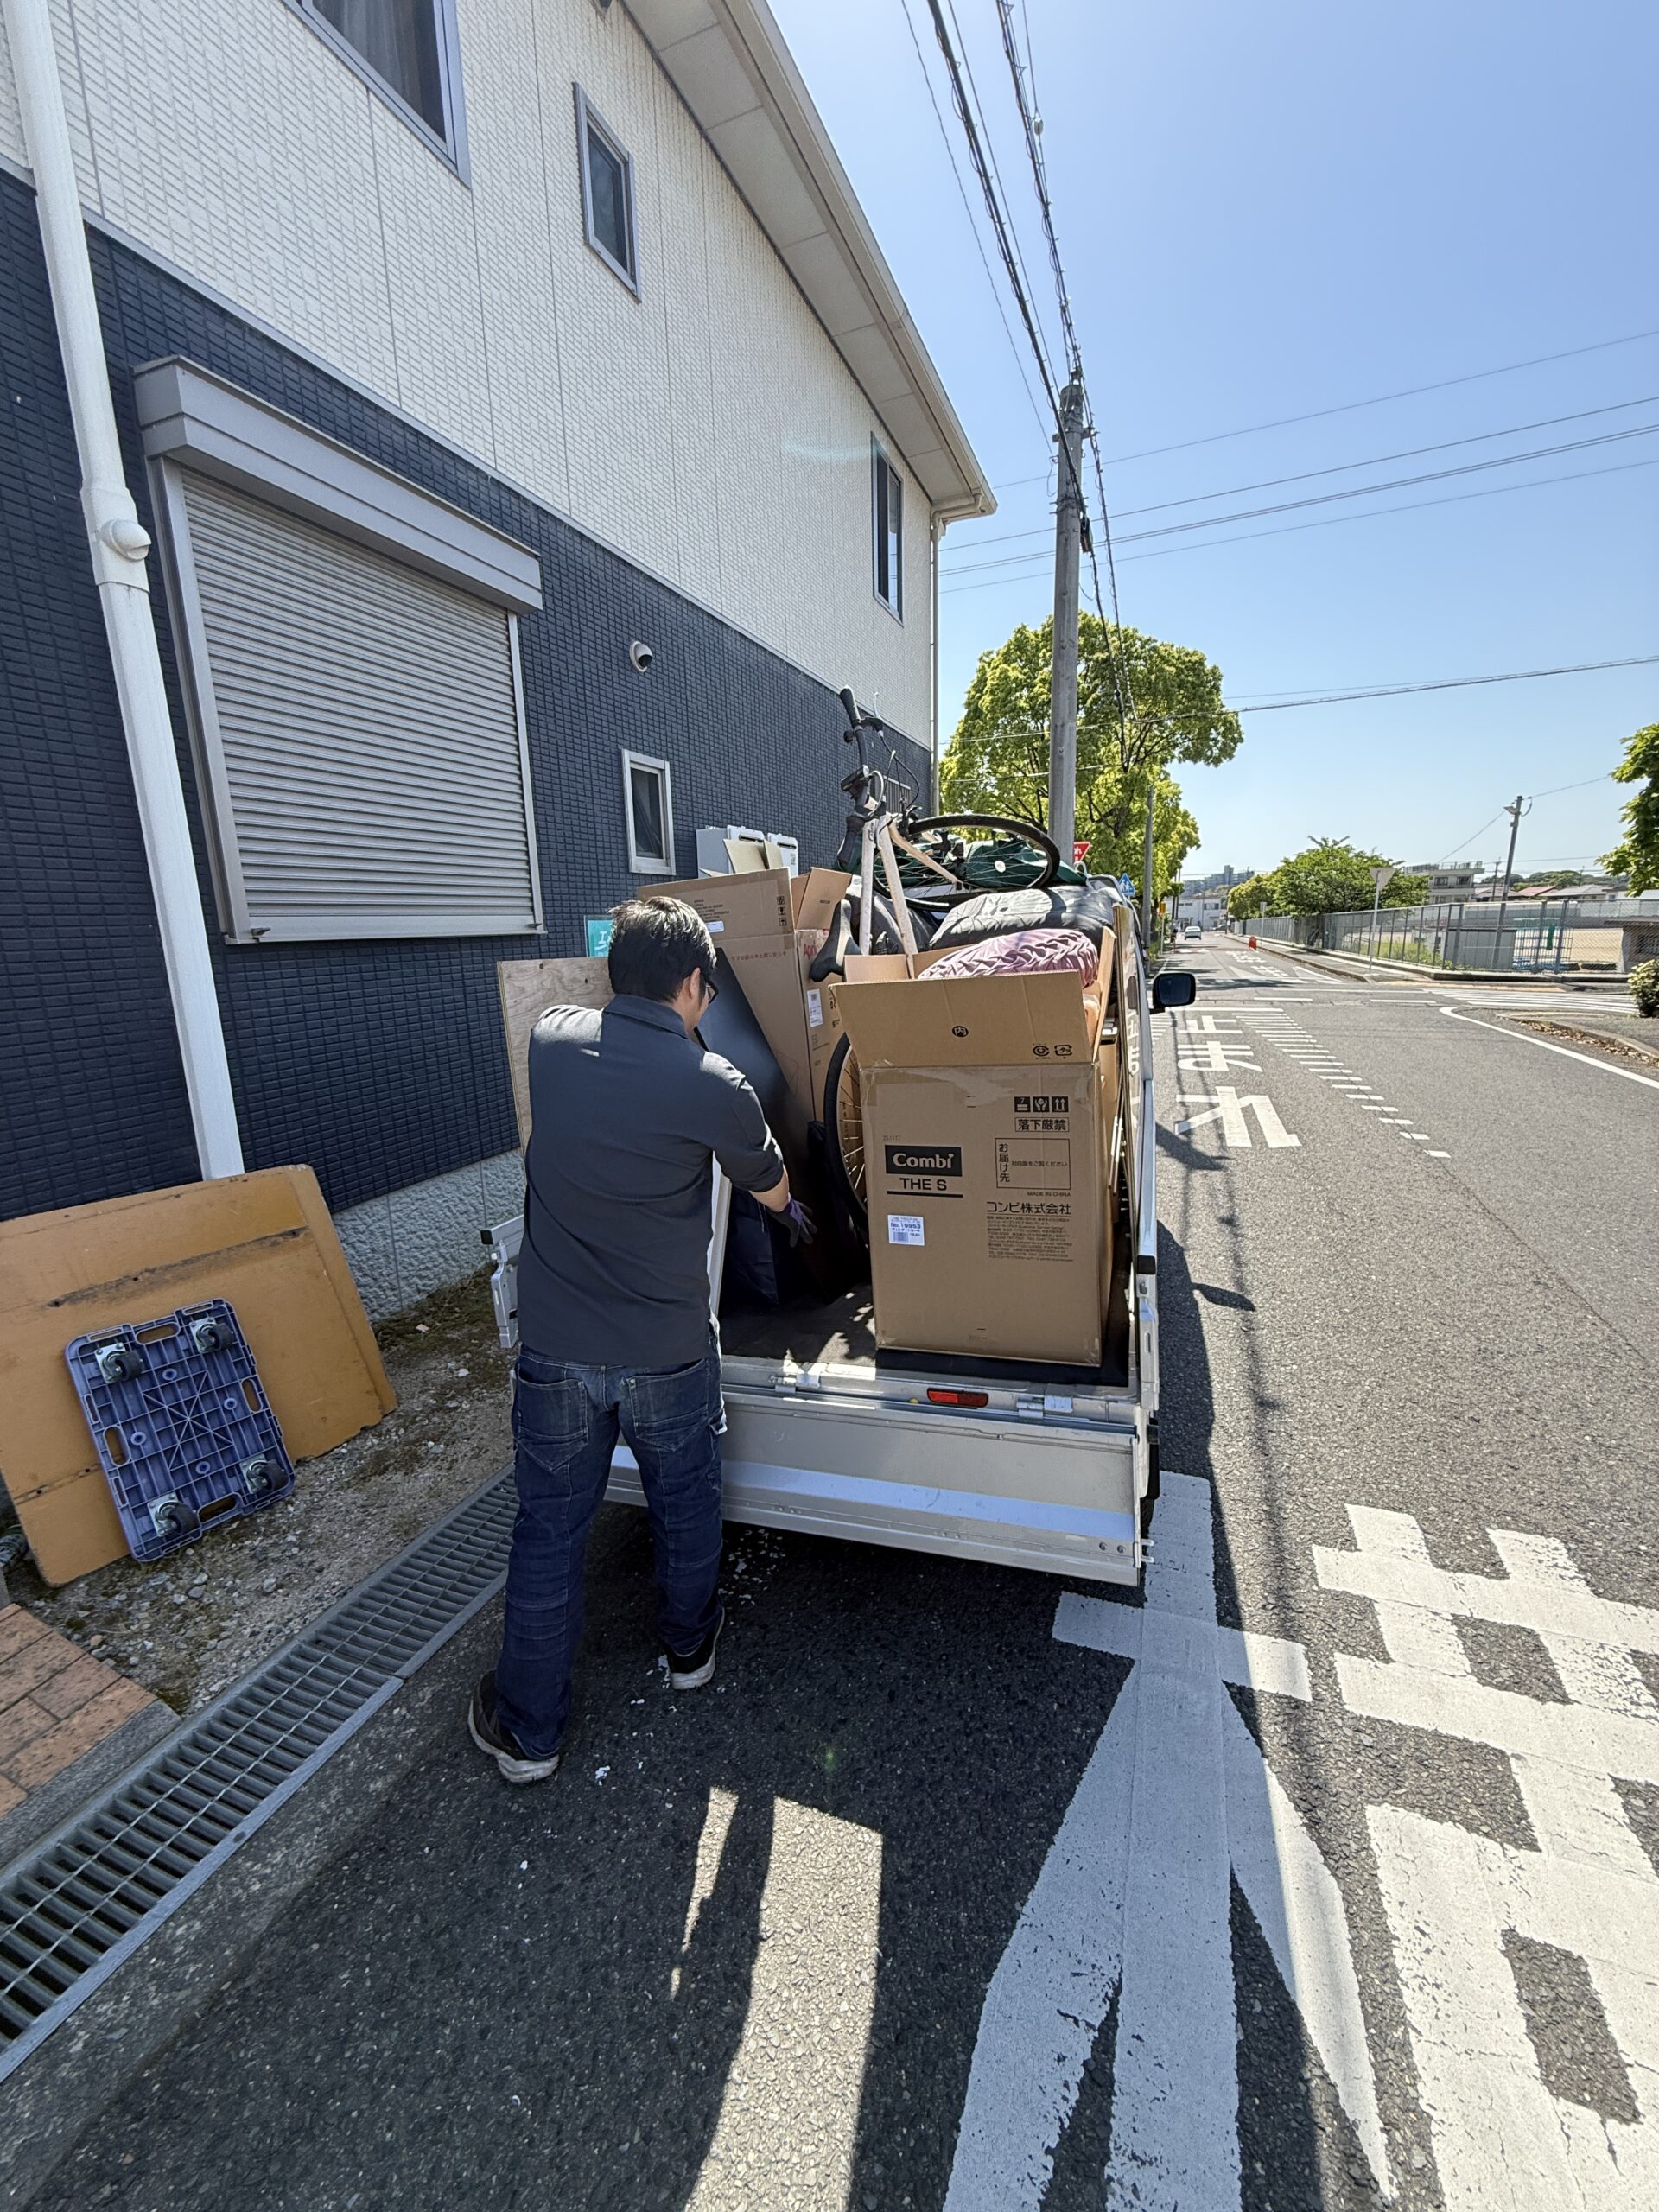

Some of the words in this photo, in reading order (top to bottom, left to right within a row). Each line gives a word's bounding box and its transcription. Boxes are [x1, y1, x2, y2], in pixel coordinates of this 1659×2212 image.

[954, 1026, 967, 1037] 内
[1174, 1015, 1302, 1148] 止まれ
[1018, 1118, 1066, 1131] 落下厳禁
[893, 1153, 954, 1168] Combi
[999, 1143, 1010, 1182] お届け先
[899, 1177, 931, 1190] THE
[937, 1179, 947, 1191] S
[986, 1201, 1071, 1215] コンビ株式会社
